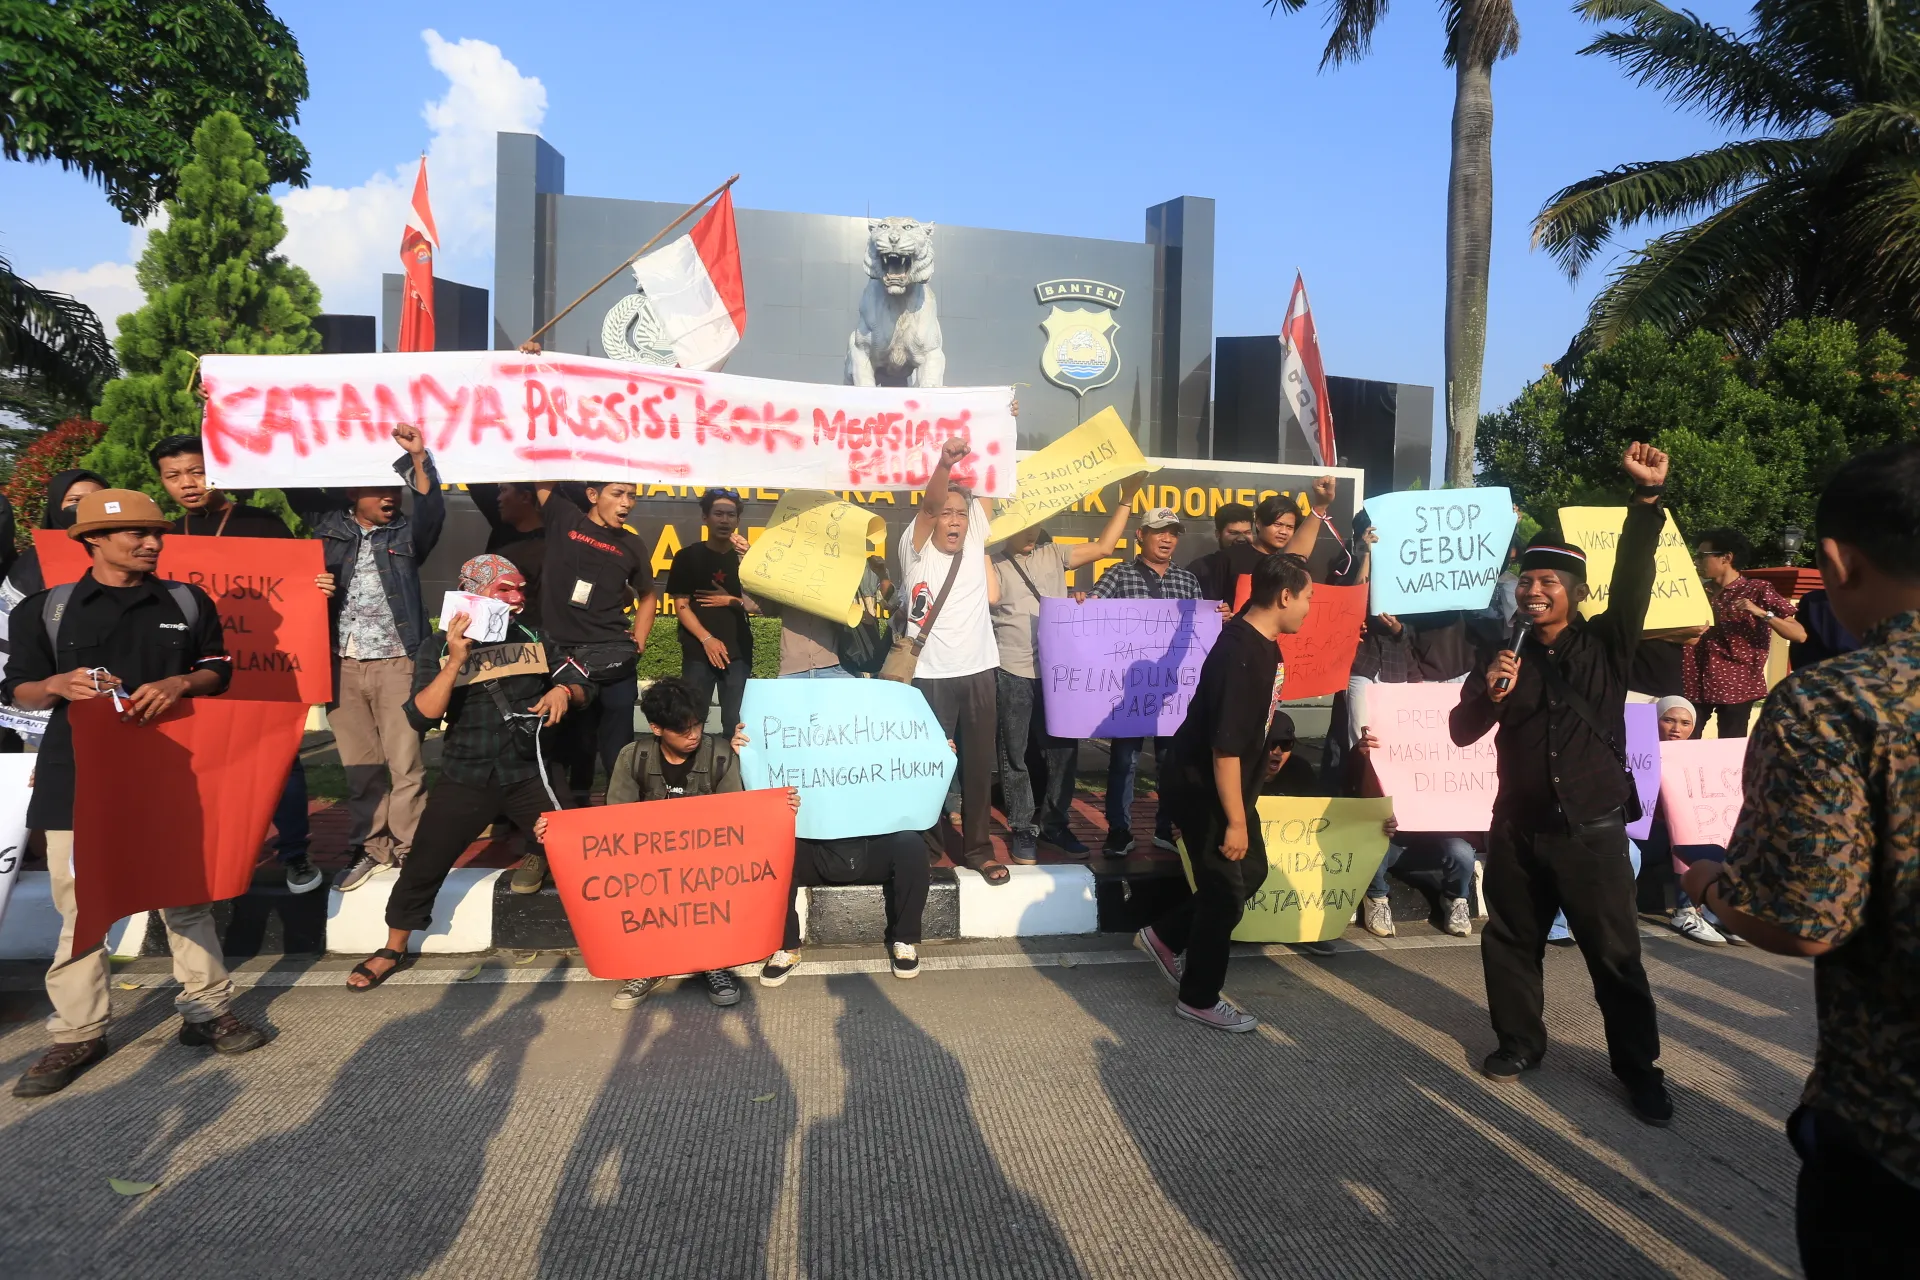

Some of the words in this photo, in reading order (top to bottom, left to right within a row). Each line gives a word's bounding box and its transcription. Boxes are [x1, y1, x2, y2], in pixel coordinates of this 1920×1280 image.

[1044, 284, 1118, 302] BANTEN
[203, 374, 514, 466] KATANYA
[1073, 439, 1118, 475] POLISI
[1042, 483, 1074, 499] JADI
[1415, 503, 1482, 533] STOP
[753, 505, 801, 579] POLISI
[1400, 532, 1496, 565] GEBUK
[1577, 530, 1622, 550] WART
[189, 571, 284, 602] BUSUK
[52, 603, 64, 622] torch
[233, 650, 303, 673] LANYA
[1052, 664, 1196, 692] PELINDUNG
[1109, 692, 1191, 720] PABRI
[16, 719, 47, 729] BANT
[1389, 743, 1439, 762] MASIH
[1446, 742, 1496, 761] MERA
[768, 762, 886, 788] MELANGGAR
[891, 757, 943, 781] HUKUM
[1415, 772, 1435, 792] DI
[1445, 771, 1498, 792] BANT
[582, 833, 629, 860] PAK
[633, 825, 744, 855] PRESIDEN
[1260, 818, 1331, 848] TOP
[1268, 851, 1353, 874] MIDASI
[582, 868, 672, 901] COPOT
[680, 859, 777, 893] KAPOLDA
[621, 900, 731, 934] BANTEN
